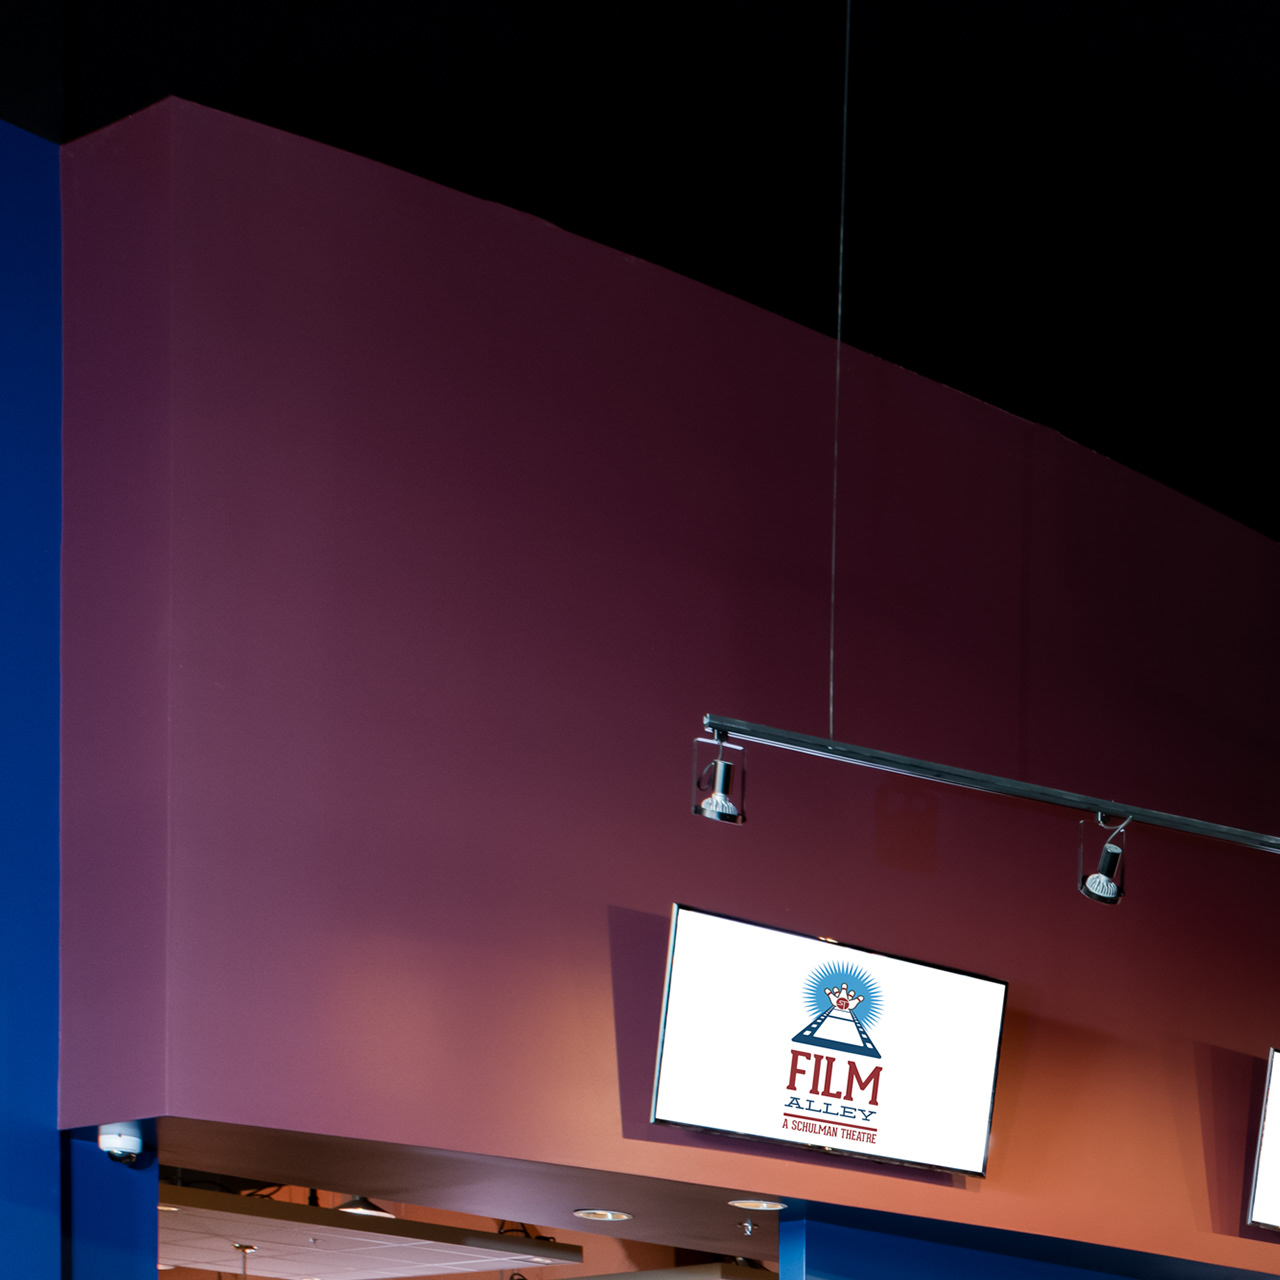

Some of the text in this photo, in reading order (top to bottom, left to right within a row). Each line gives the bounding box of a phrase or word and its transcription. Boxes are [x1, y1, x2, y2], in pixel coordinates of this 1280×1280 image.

[786, 1049, 883, 1106] FILM
[784, 1096, 877, 1121] ALLEY
[782, 1118, 877, 1144] A SCHULMAN THEATRE
